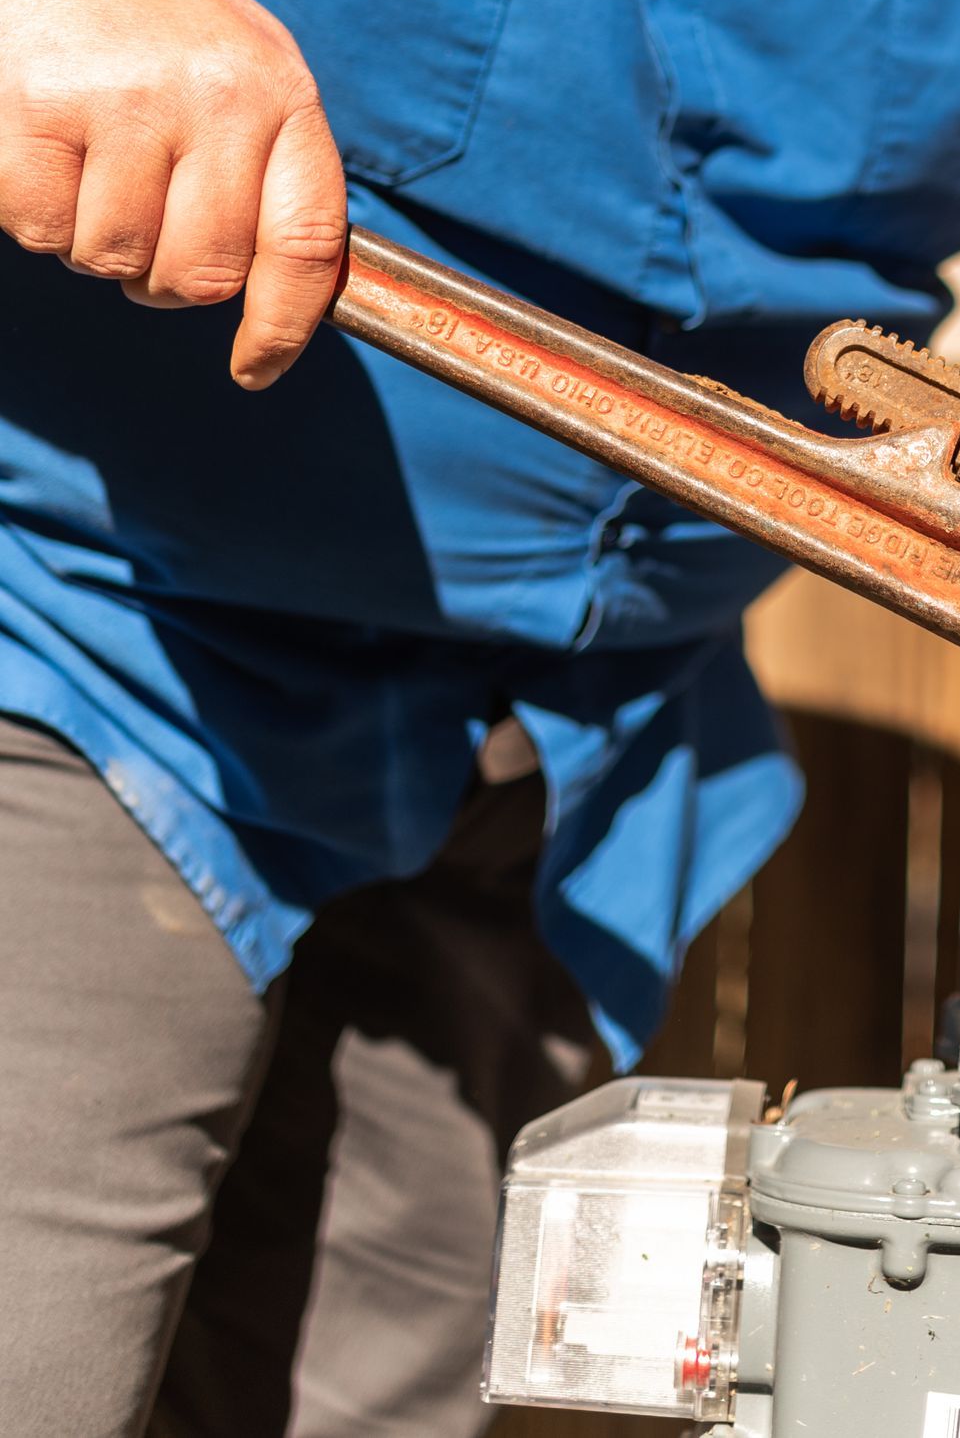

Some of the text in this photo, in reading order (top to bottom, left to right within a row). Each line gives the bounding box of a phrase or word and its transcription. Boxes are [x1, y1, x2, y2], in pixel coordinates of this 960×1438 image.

[465, 328, 542, 380] U.S.A.
[550, 371, 616, 416] OHIO
[718, 454, 766, 489] CO.
[771, 477, 842, 527] TOOL
[847, 515, 929, 568] RIDGE
